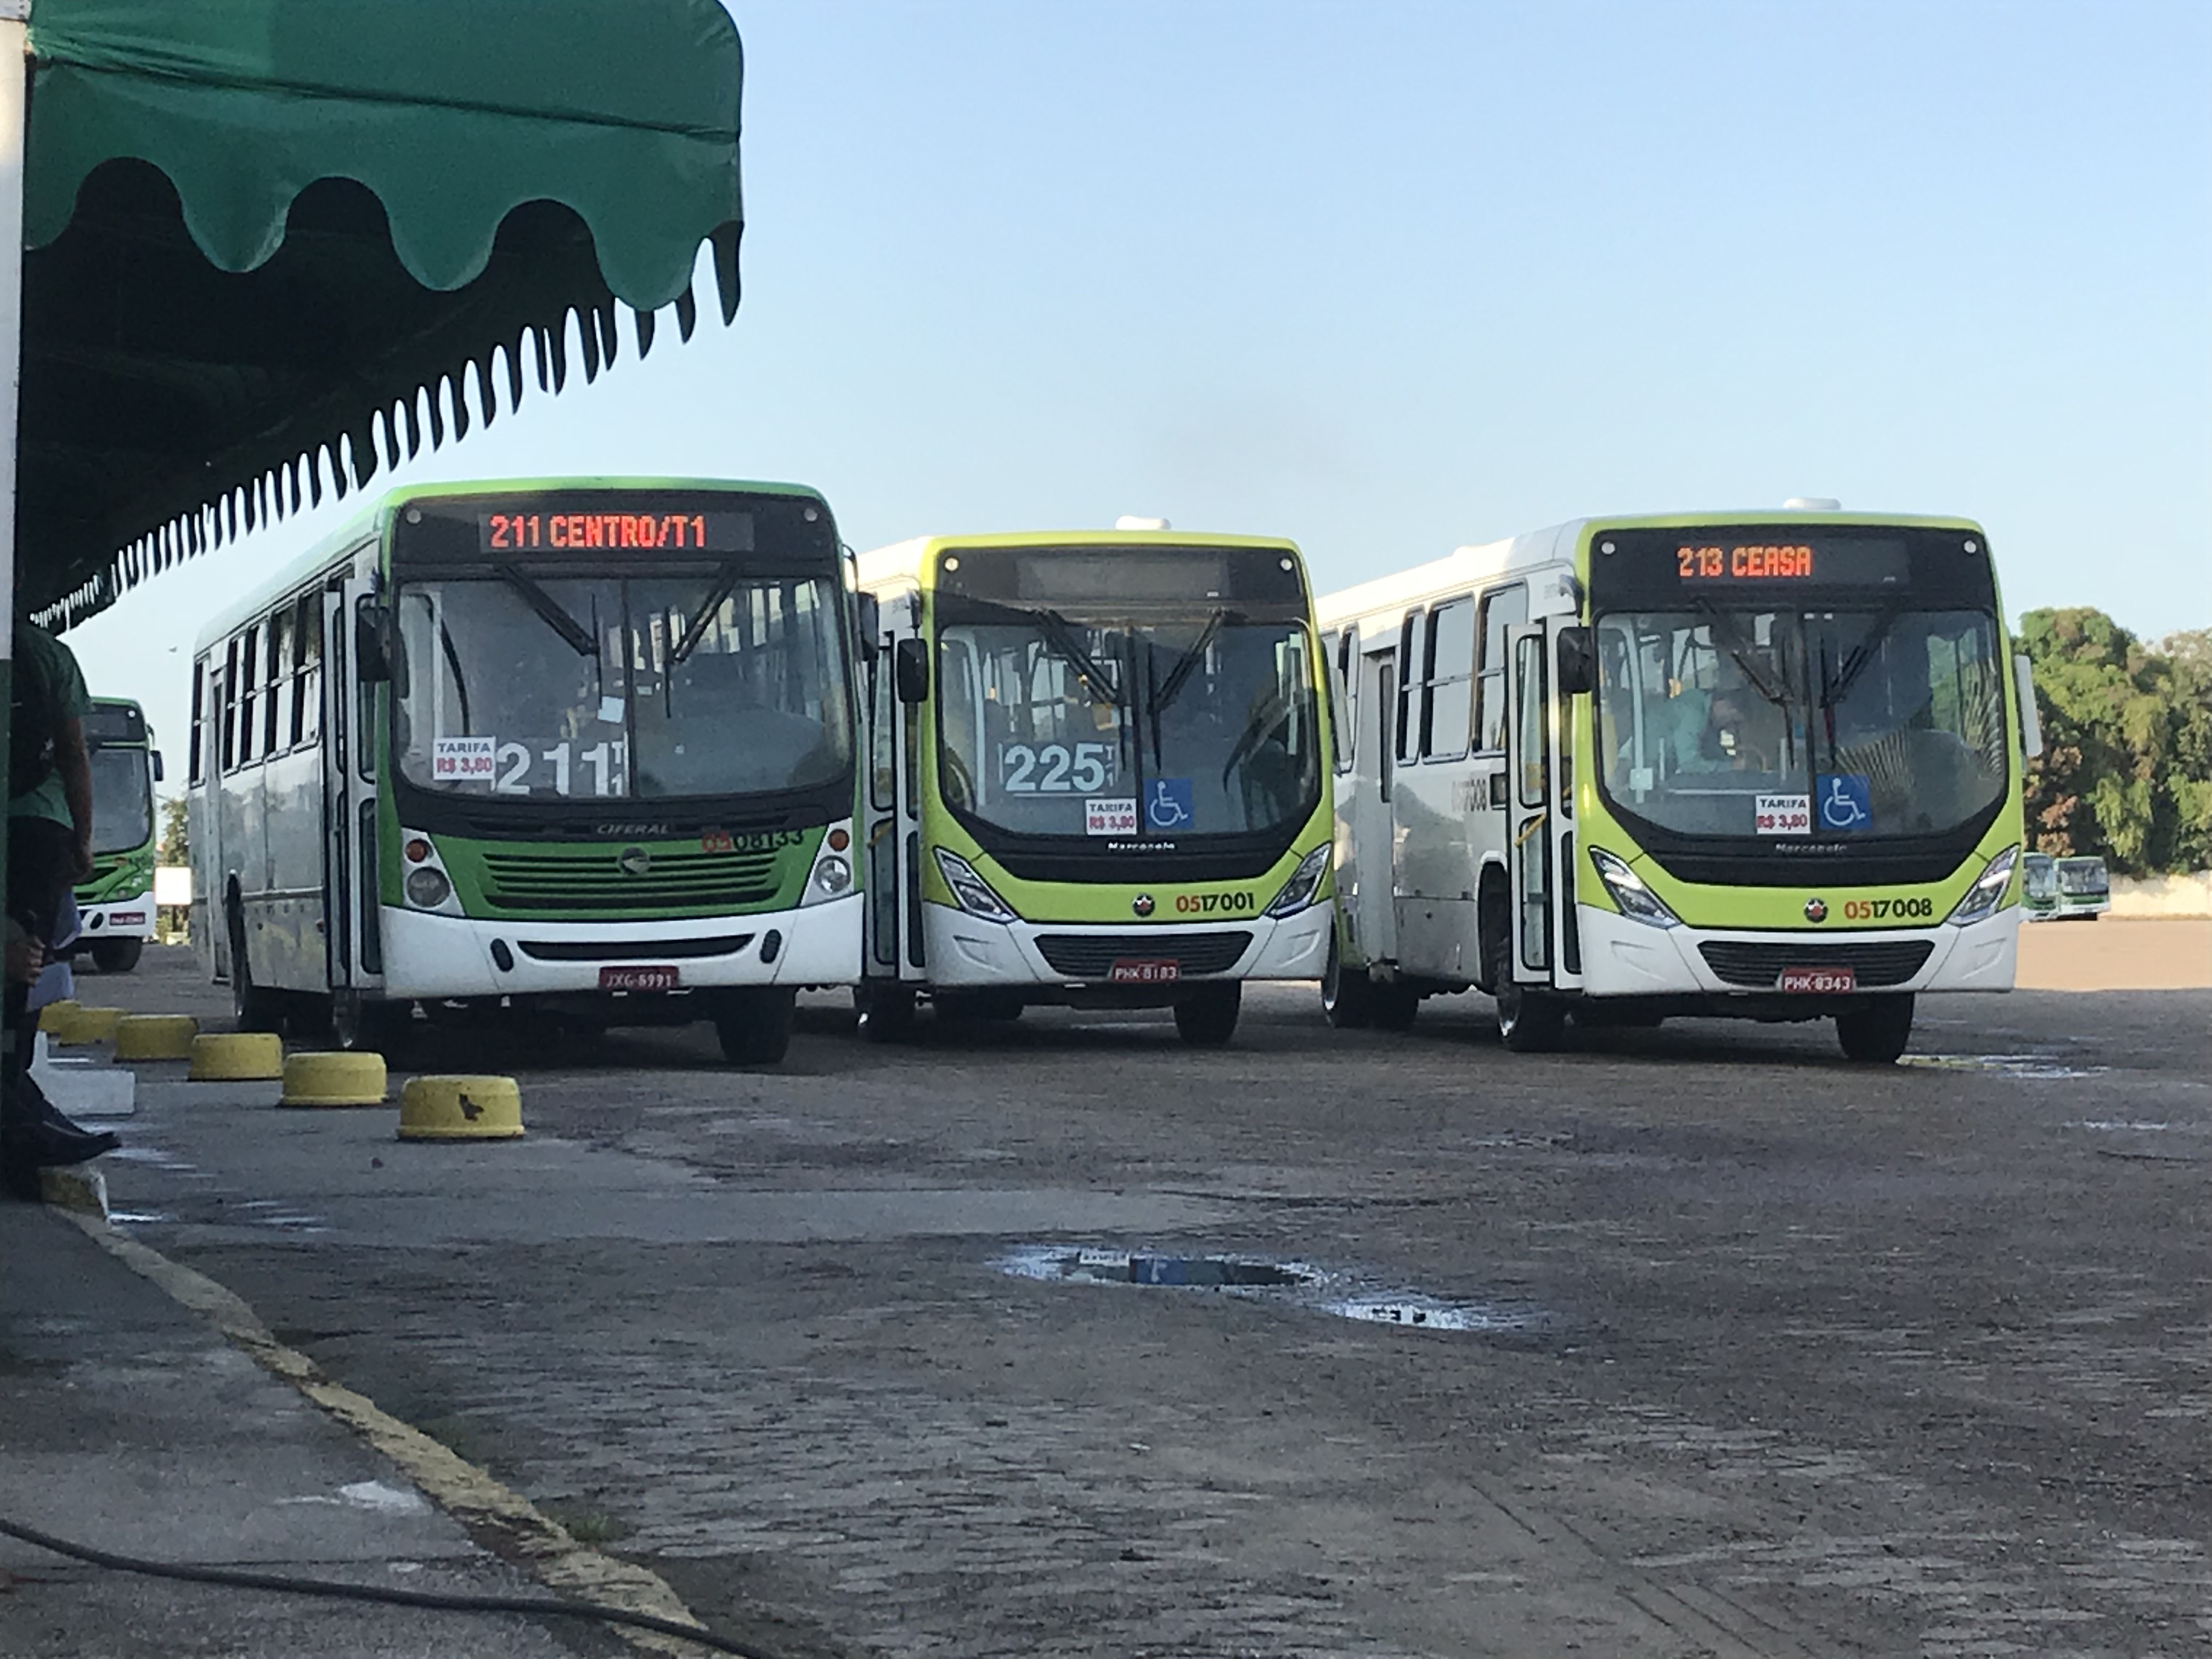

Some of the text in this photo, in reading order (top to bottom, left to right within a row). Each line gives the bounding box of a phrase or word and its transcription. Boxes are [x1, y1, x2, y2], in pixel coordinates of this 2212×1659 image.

[490, 515, 704, 548] 211 CENTRO/T1
[1677, 546, 1812, 577] 213 CEASA
[438, 742, 491, 753] TARIFA
[496, 742, 608, 795] 211
[1005, 743, 1105, 792] 225
[1089, 803, 1133, 812] TARIFA
[1759, 799, 1807, 809] TARIFA
[1175, 892, 1255, 913] 0517001
[1844, 898, 1933, 919] 0517008
